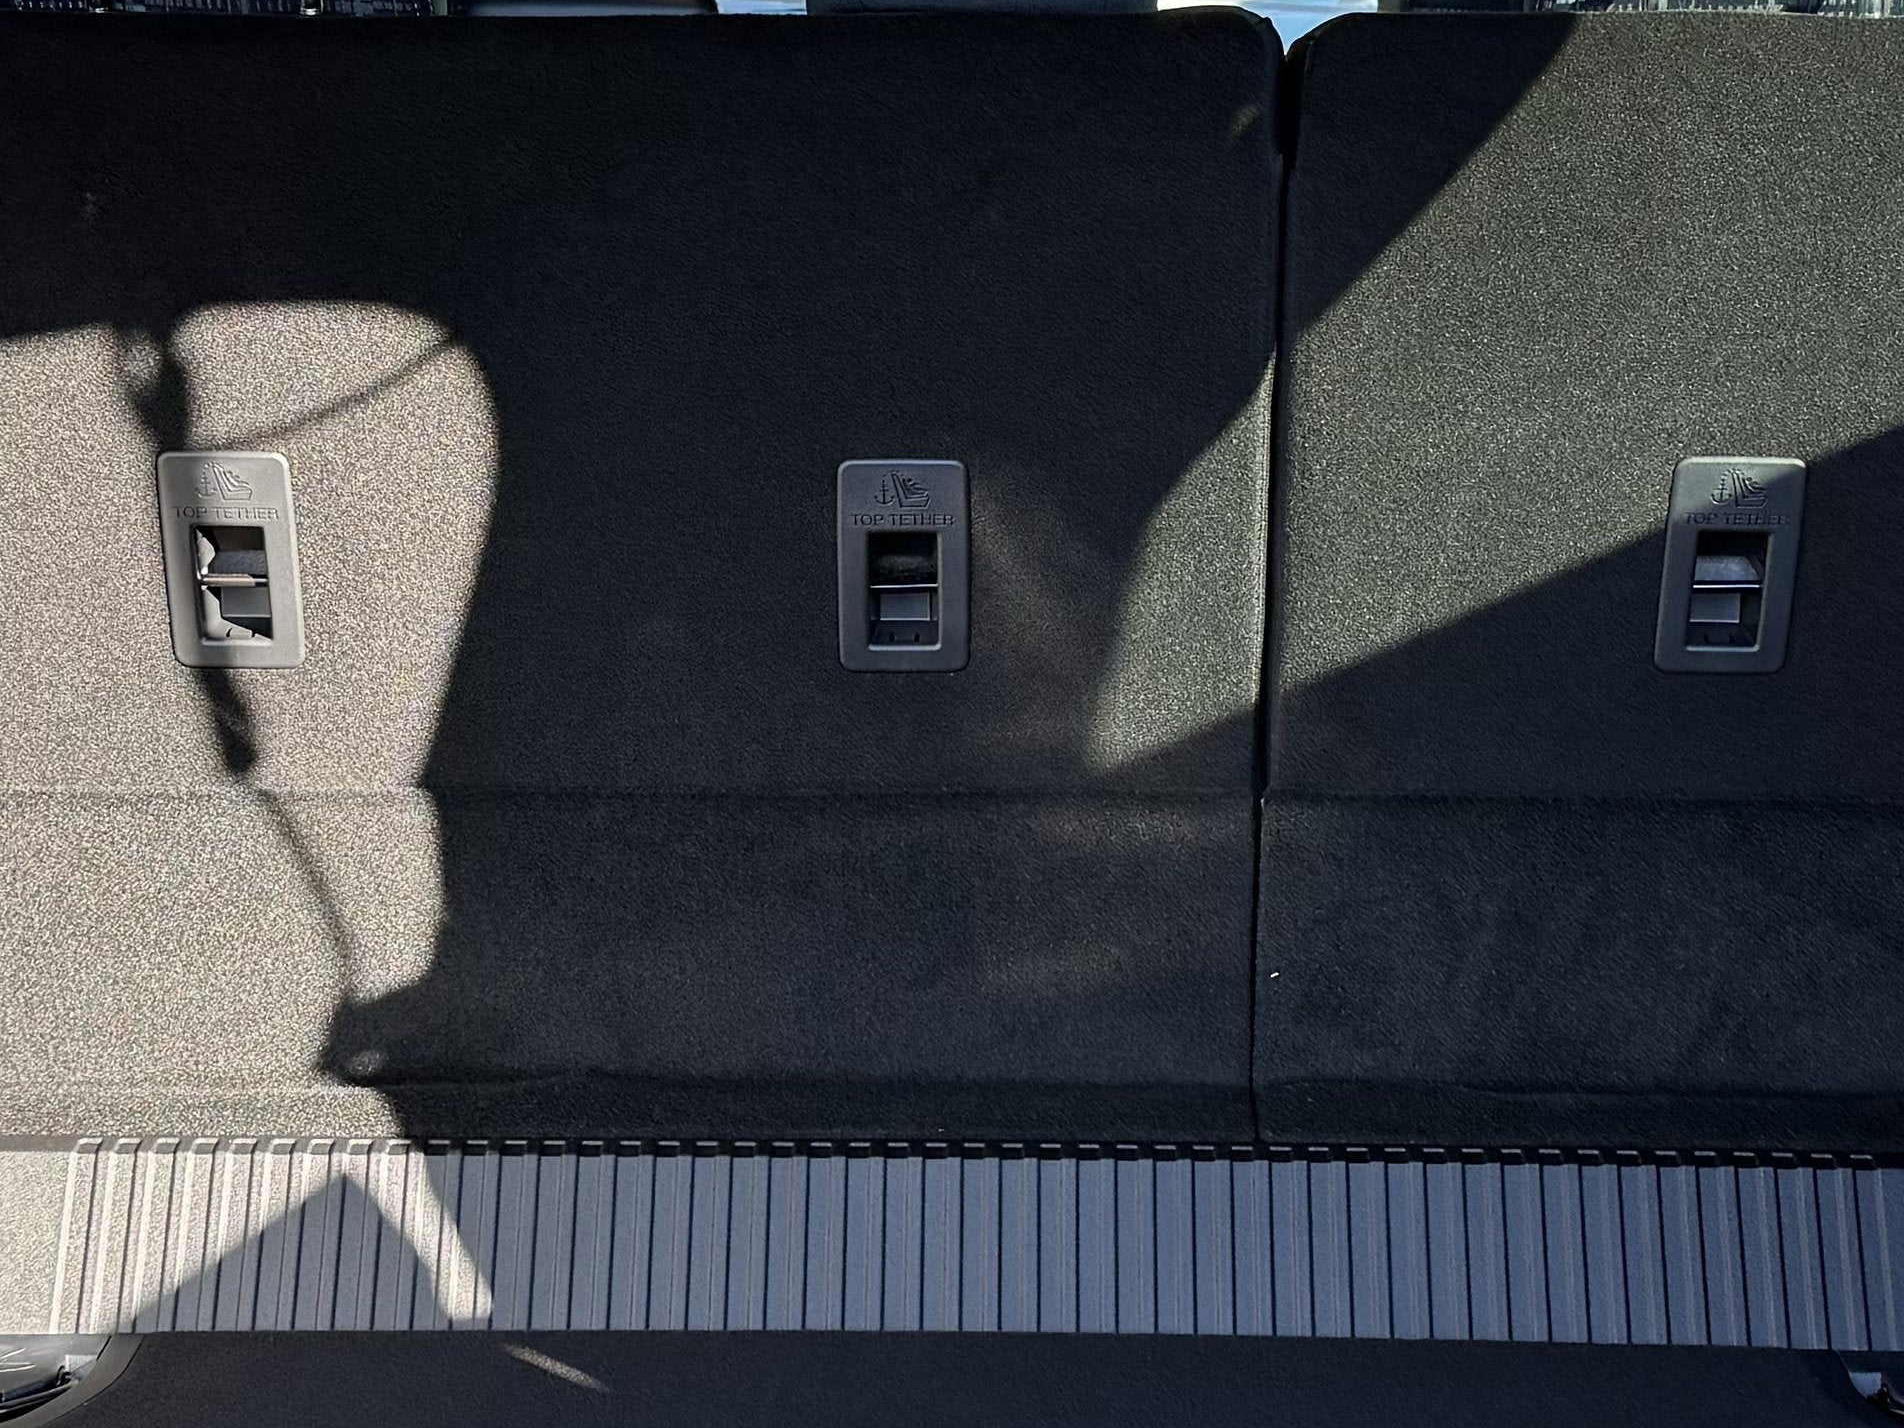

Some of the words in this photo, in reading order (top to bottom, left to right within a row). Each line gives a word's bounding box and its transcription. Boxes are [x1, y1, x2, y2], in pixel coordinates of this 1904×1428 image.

[173, 505, 208, 519] TOP
[215, 506, 279, 520] TETHER
[1685, 513, 1718, 525] TOP
[1723, 513, 1789, 525] TETHER
[851, 513, 884, 526] TOP
[889, 513, 955, 526] TETHER
